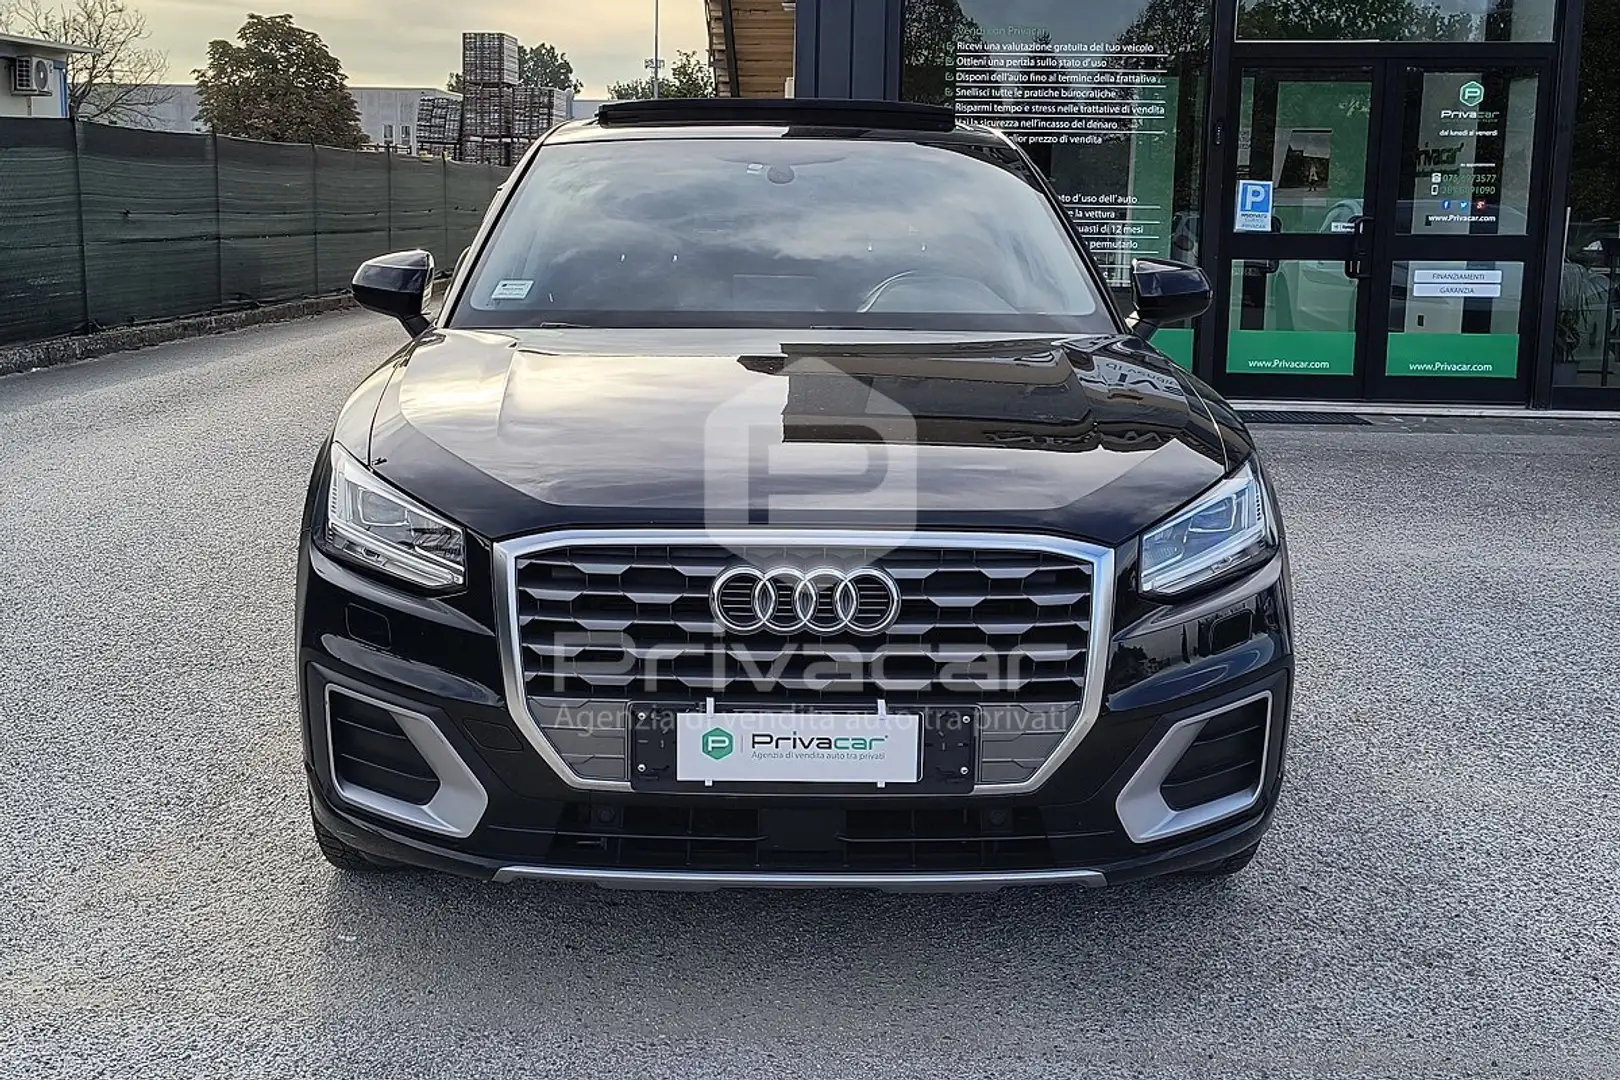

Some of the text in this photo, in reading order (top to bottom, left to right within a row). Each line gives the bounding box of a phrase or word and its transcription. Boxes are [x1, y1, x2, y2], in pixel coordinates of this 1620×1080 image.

[957, 42, 982, 50] Ricevi
[1002, 42, 1052, 51] valutazione
[1054, 43, 1088, 52] gratuita
[1090, 43, 1104, 51] del
[1122, 44, 1154, 52] veicolo
[956, 57, 986, 66] Ottieni
[1006, 58, 1035, 68] perizia
[1036, 58, 1057, 66] sullo
[1059, 59, 1080, 68] stato
[1082, 58, 1107, 68] d'uso
[956, 72, 1157, 84] Disponi dell'auto fino al termine della trattativa
[956, 88, 1116, 99] Snellisci tutte le pratiche burocratiche
[955, 102, 992, 113] Risparmi
[994, 104, 1022, 114] tempo
[1032, 105, 1056, 113] stress
[1057, 104, 1079, 113] nelle
[1080, 104, 1120, 114] trattative
[1122, 105, 1130, 114] di
[1132, 105, 1165, 115] vendita
[1440, 110, 1500, 118] Privacar
[980, 119, 1019, 128] sicurezza
[1020, 119, 1070, 128] nell'incasso
[1071, 120, 1086, 128] del
[1086, 120, 1118, 129] denaro
[1028, 136, 1058, 144] prezzo
[1060, 134, 1068, 144] di
[1070, 135, 1102, 144] vendita
[1072, 193, 1098, 203] d'uso
[1098, 194, 1138, 204] dell'auto
[1245, 184, 1265, 210] P
[1074, 209, 1082, 218] la
[1084, 210, 1116, 218] vettura
[1428, 214, 1496, 222] www.Privacar.com
[1077, 224, 1144, 234] uasti di 12 mesi
[1090, 240, 1138, 249] permutarlo
[1248, 360, 1330, 368] www.Privacar.com
[1409, 362, 1493, 371] www.Privacar.com
[752, 731, 886, 750] Privacar
[751, 751, 784, 760] Agenzia
[785, 751, 794, 759] di
[795, 752, 824, 760] vendita
[859, 752, 886, 762] privati
